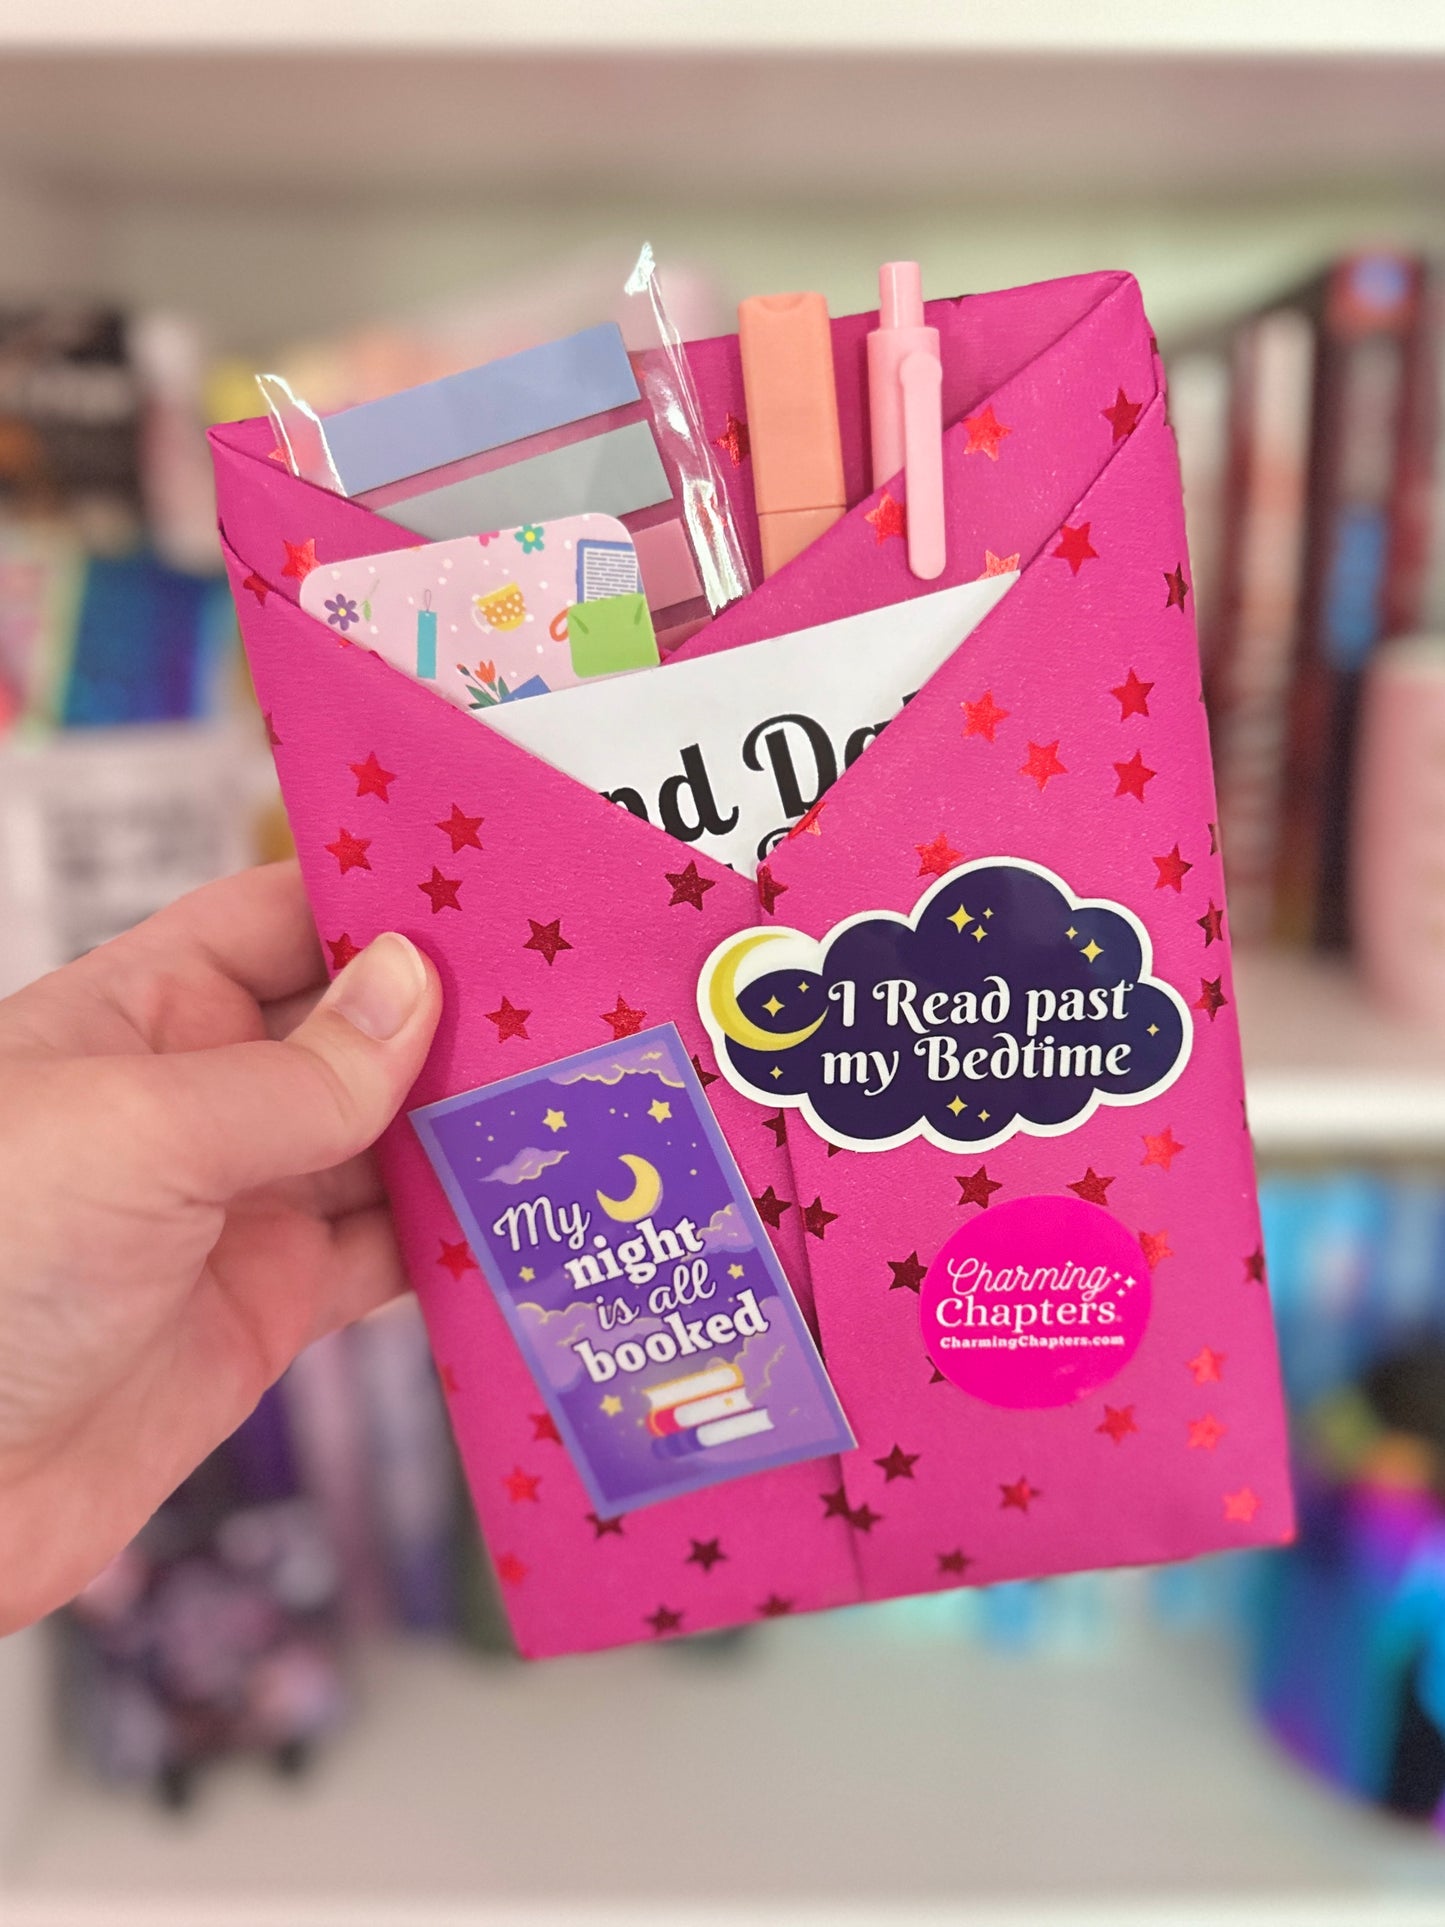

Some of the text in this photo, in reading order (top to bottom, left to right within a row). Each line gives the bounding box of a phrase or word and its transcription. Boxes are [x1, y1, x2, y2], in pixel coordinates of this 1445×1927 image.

[827, 976, 1134, 1036] I Read past
[821, 1032, 1132, 1096] my Bedtime
[493, 1196, 590, 1252] My
[564, 1216, 704, 1290] night
[596, 1258, 716, 1330] is all
[947, 1257, 1112, 1301] Charming
[573, 1290, 770, 1383] booked
[935, 1295, 1116, 1333] Chapters
[940, 1335, 1125, 1350] CharmingChapters.com
